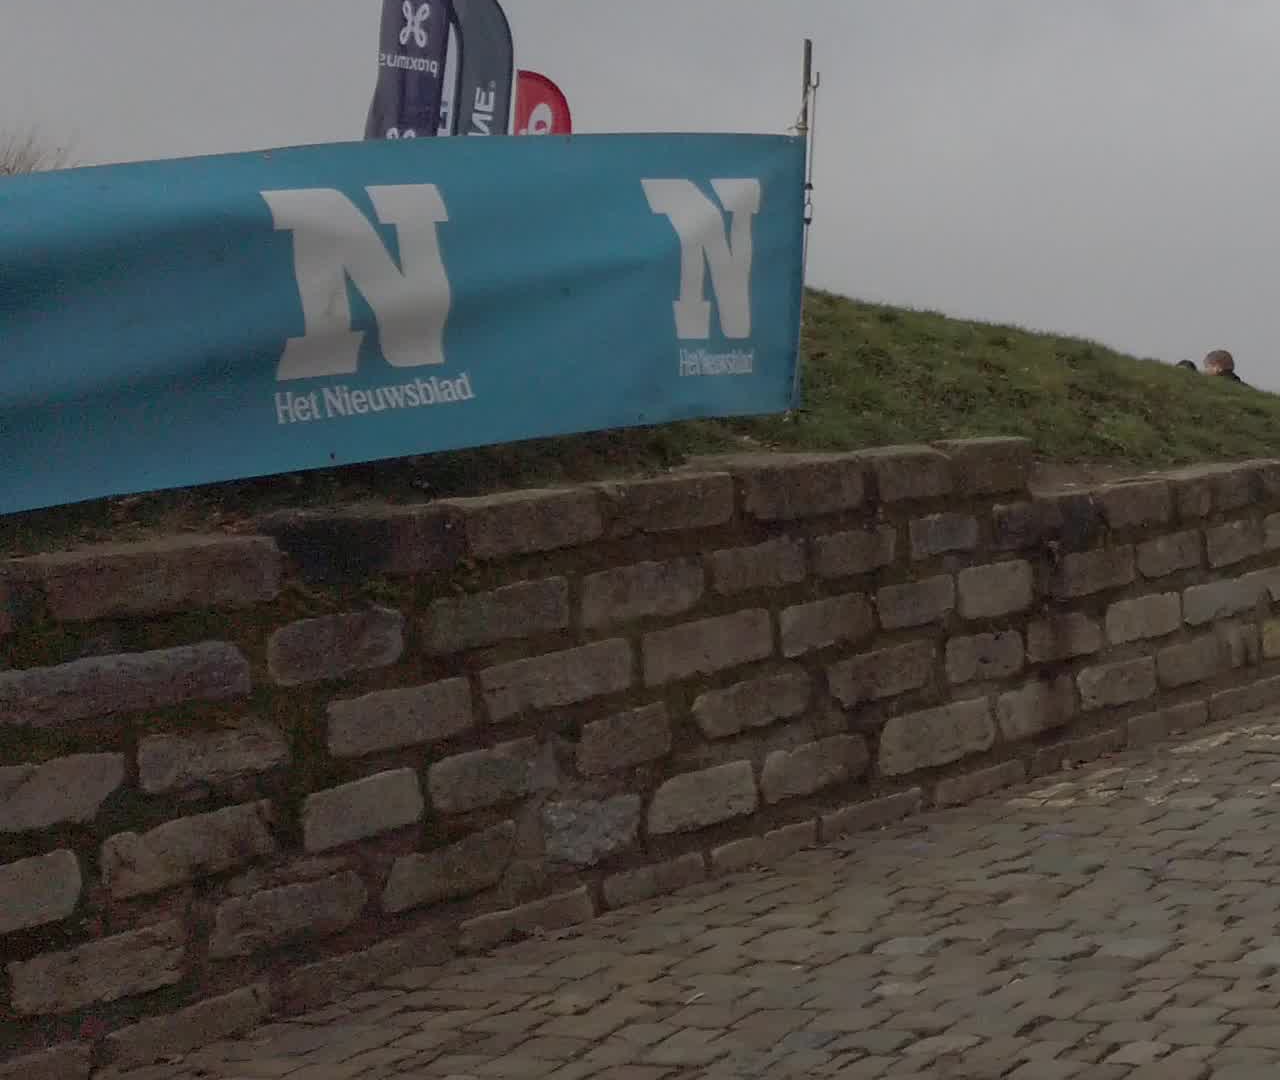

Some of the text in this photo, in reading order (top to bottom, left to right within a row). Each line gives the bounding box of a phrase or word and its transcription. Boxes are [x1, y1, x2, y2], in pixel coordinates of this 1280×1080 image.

[260, 183, 450, 381] N
[641, 178, 761, 339] N
[275, 371, 475, 425] Het Nieuwsblad
